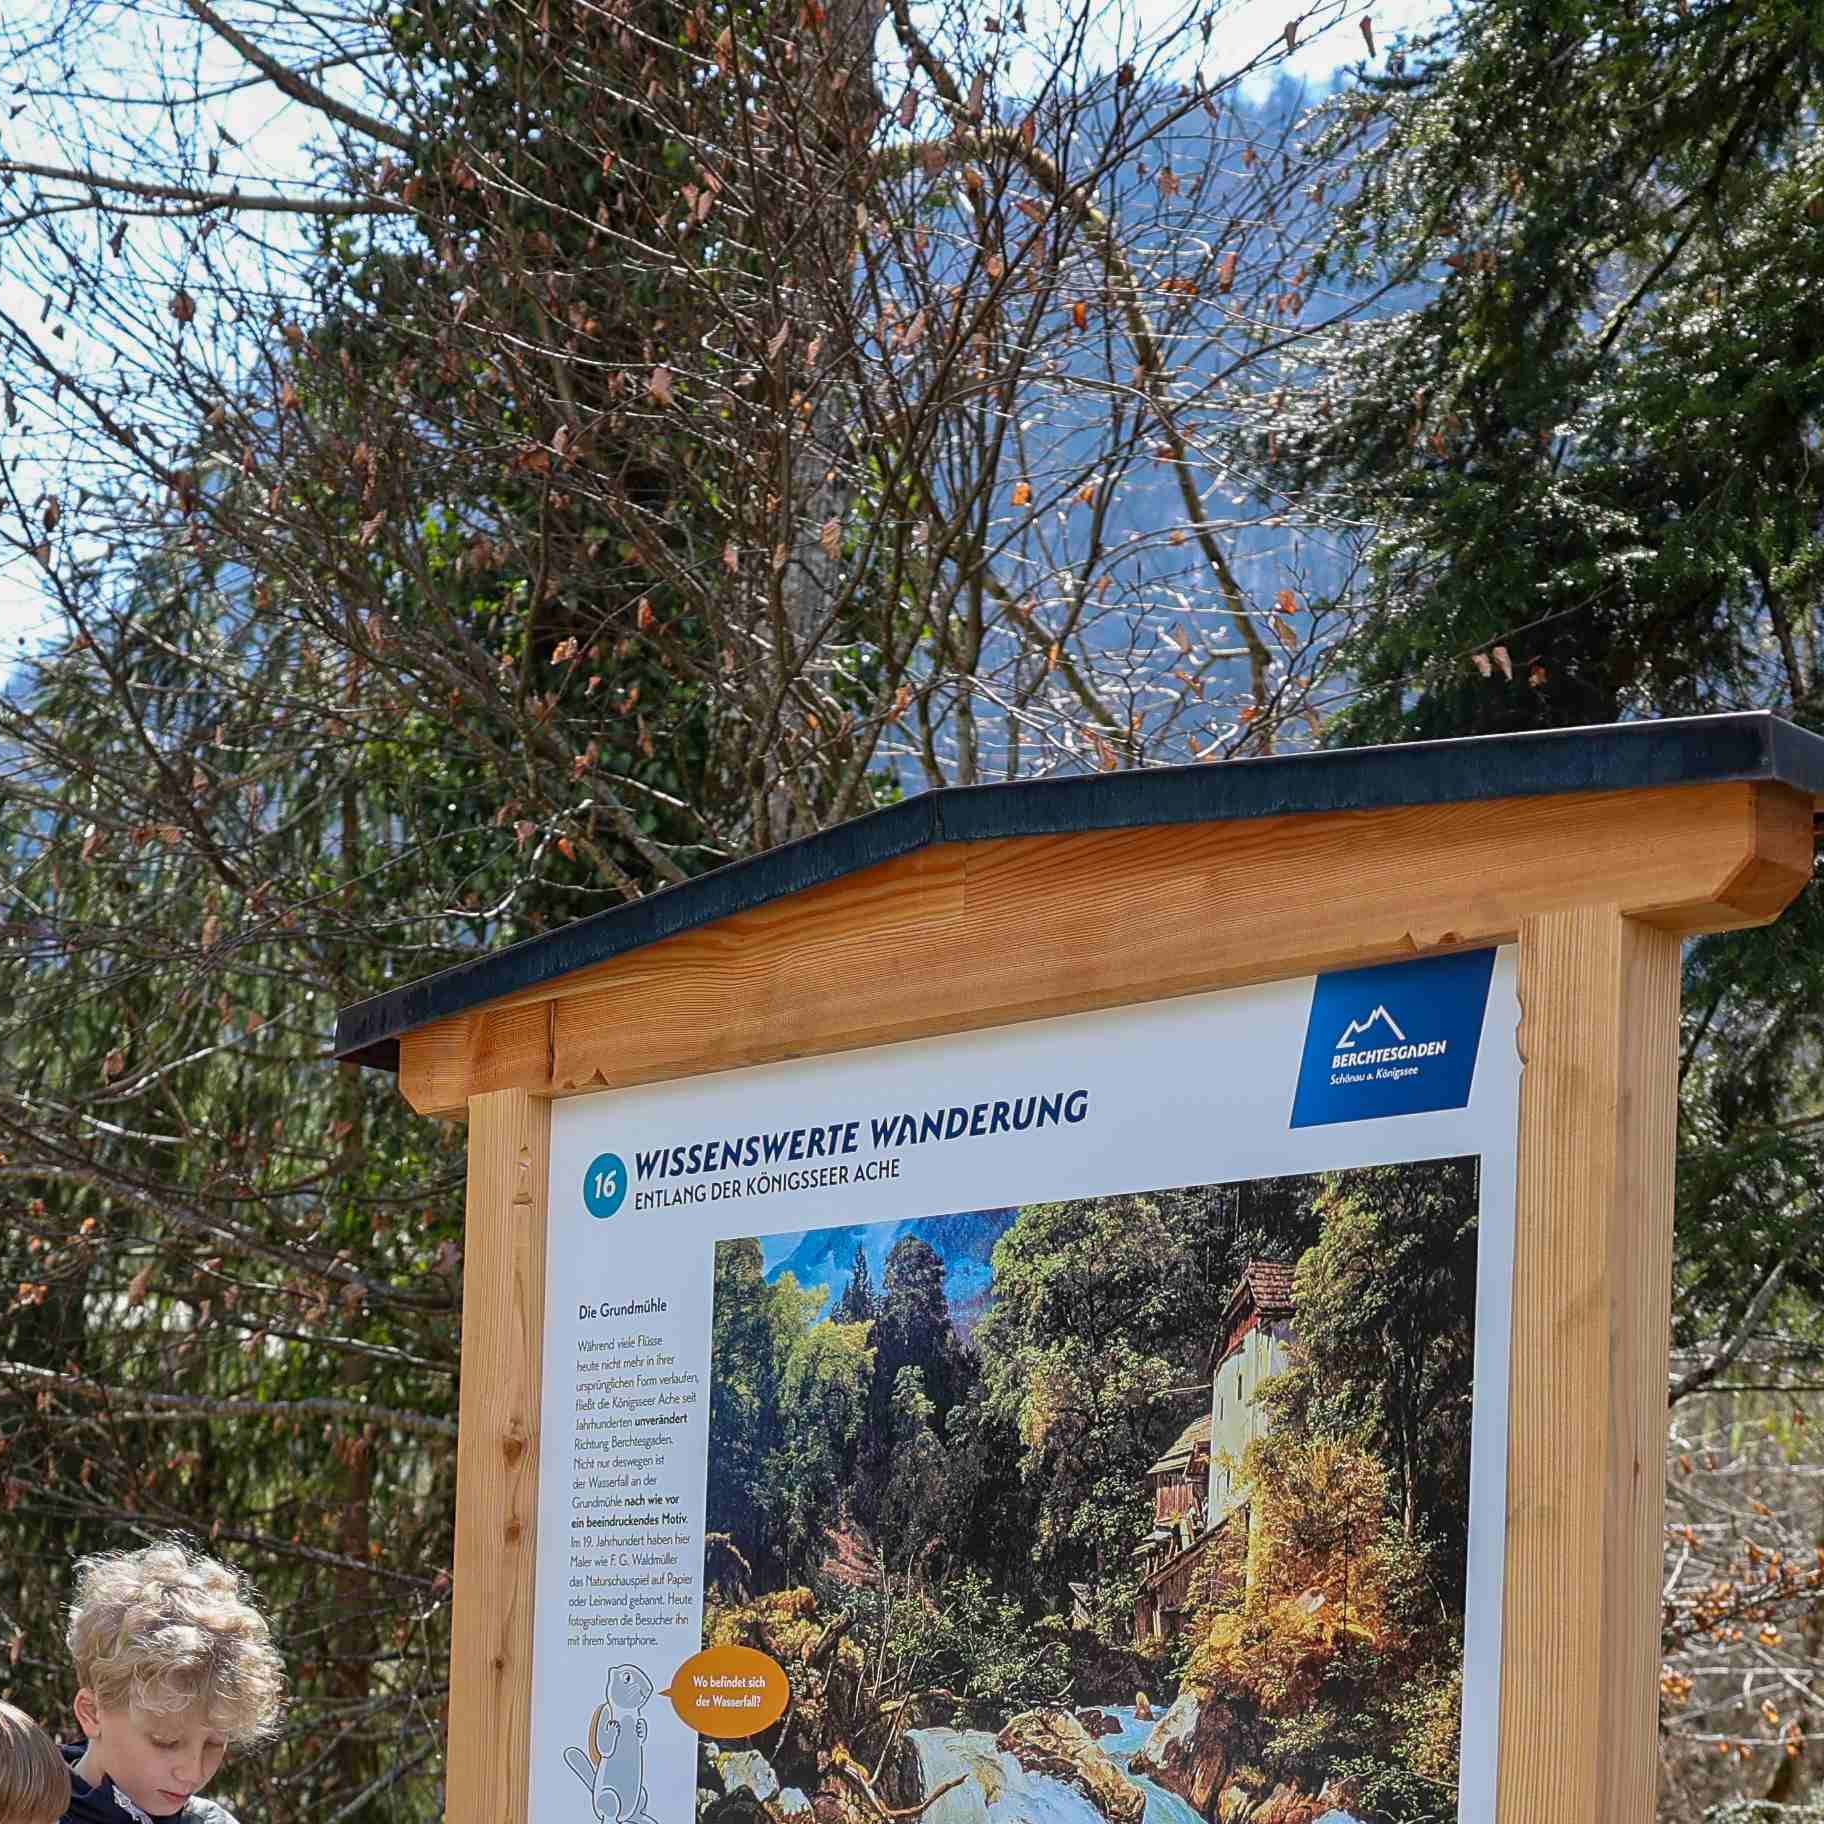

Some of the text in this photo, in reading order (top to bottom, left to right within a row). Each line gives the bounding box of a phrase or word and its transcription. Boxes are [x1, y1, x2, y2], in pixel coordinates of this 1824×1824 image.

[1331, 1039, 1447, 1069] BERCHTESGADEN
[1329, 1072, 1366, 1086] Schönau
[1375, 1066, 1419, 1081] Königssee
[635, 1089, 1089, 1182] WISSENSWERTE WANDERUNG
[594, 1169, 617, 1199] 16
[634, 1158, 901, 1211] ENTLANG DER KÖNIGSSEER ACHE
[578, 1296, 668, 1321] Die Grundmühle
[576, 1352, 676, 1373] heute nicht mehr in ihrer
[636, 1373, 658, 1388] Form
[575, 1391, 697, 1412] fließt die Königsseer Ache seit
[575, 1410, 688, 1431] Jahrhunderten unverändert
[573, 1437, 610, 1453] Richtung
[573, 1453, 665, 1473] Nicht nur deswegen ist
[572, 1472, 658, 1490] der Wasserfall an der
[571, 1492, 680, 1509] Grundmühle nach wie vor
[570, 1511, 689, 1529] ein beeindruckendes Motiv.
[570, 1535, 582, 1548] Im
[595, 1532, 645, 1548] Jahrhundert
[646, 1531, 674, 1546] haben
[674, 1531, 692, 1545] hier
[569, 1554, 593, 1568] Maler
[593, 1555, 609, 1567] wie
[631, 1551, 679, 1568] Waldmüller
[568, 1571, 694, 1590] das Naturschauspiel auf Papier
[568, 1594, 588, 1608] oder
[588, 1592, 629, 1609] Leinwand
[667, 1591, 695, 1608] Heute
[567, 1611, 689, 1632] fotografieren die Besucher ihn
[567, 1635, 581, 1649] mit
[581, 1632, 605, 1646] ihrem
[692, 1674, 766, 1689] Wo befindet sich
[695, 1694, 761, 1708] der Wasserfall?
